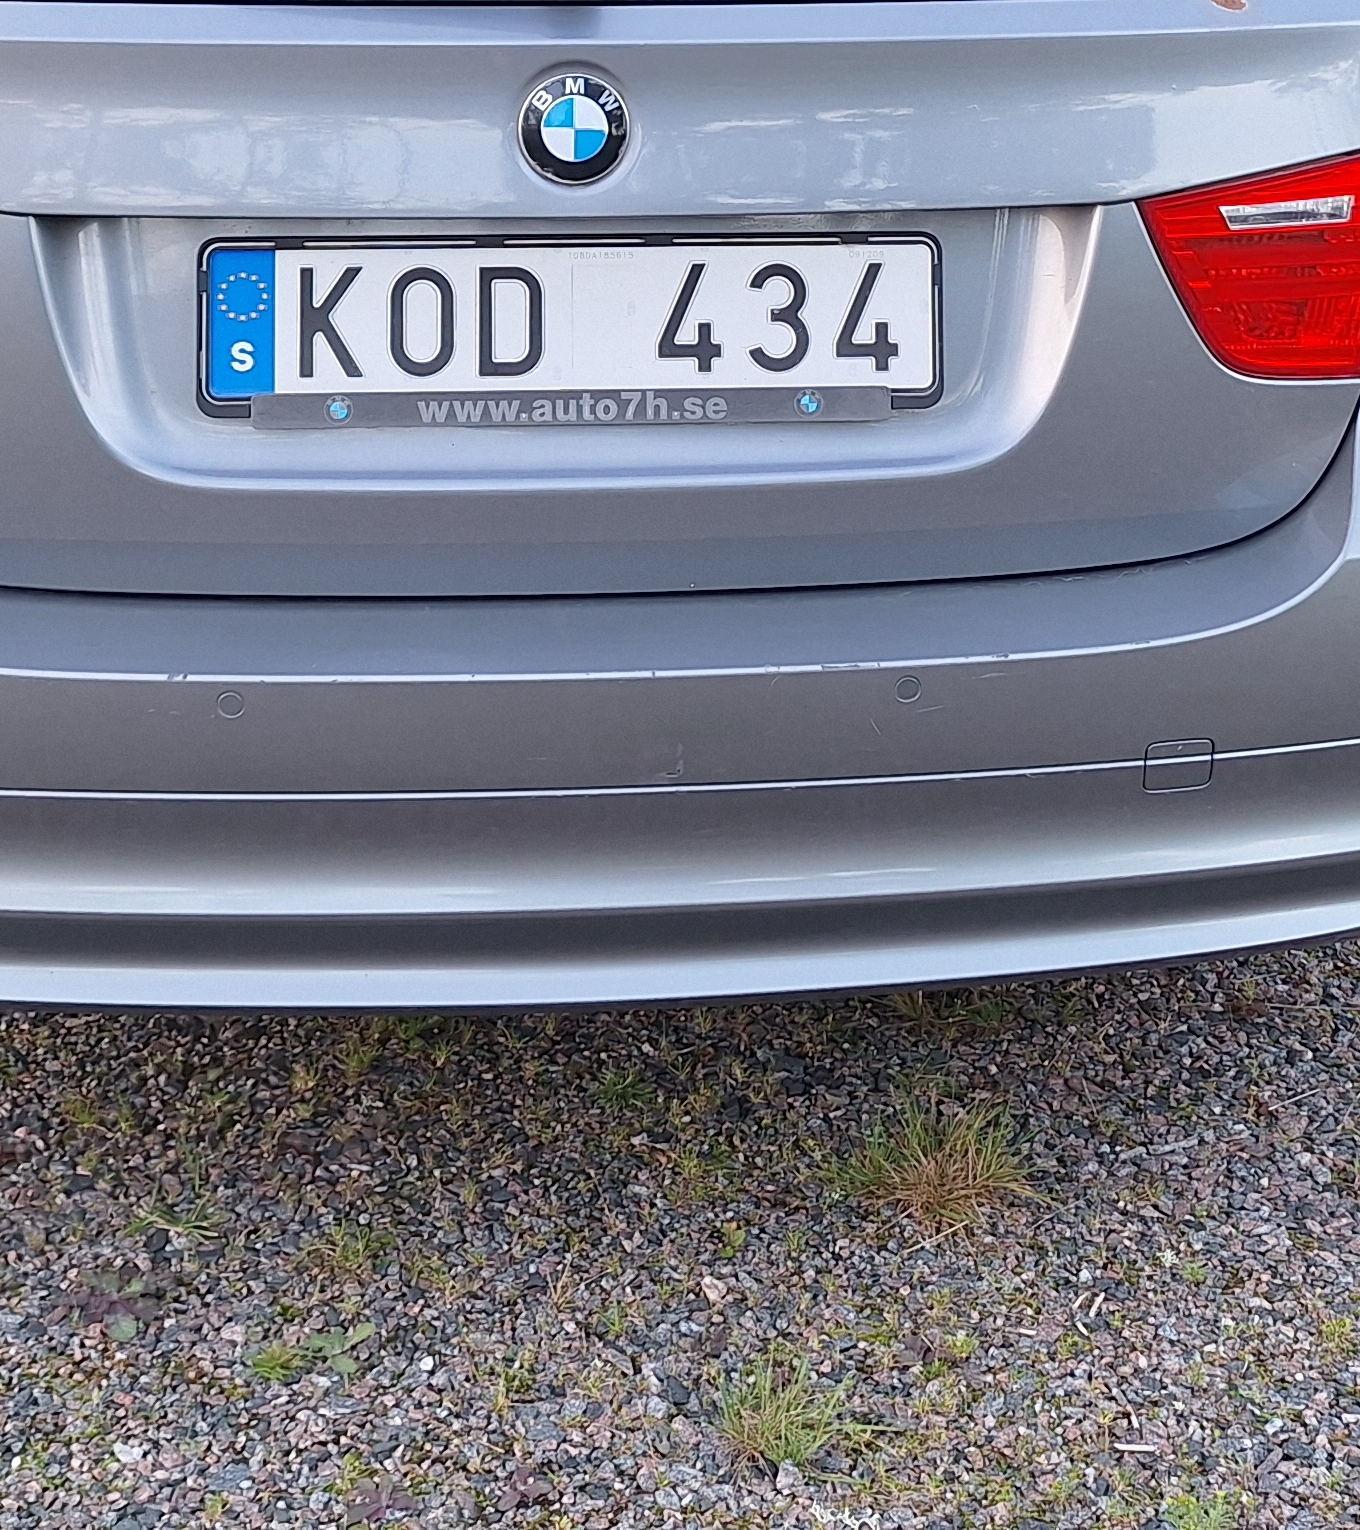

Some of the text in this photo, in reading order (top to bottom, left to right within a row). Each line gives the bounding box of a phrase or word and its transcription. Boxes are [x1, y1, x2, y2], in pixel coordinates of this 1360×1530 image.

[531, 77, 620, 112] BMW
[299, 262, 899, 378] KOD 434
[230, 341, 255, 372] S
[416, 390, 729, 424] www.auto7h.se
